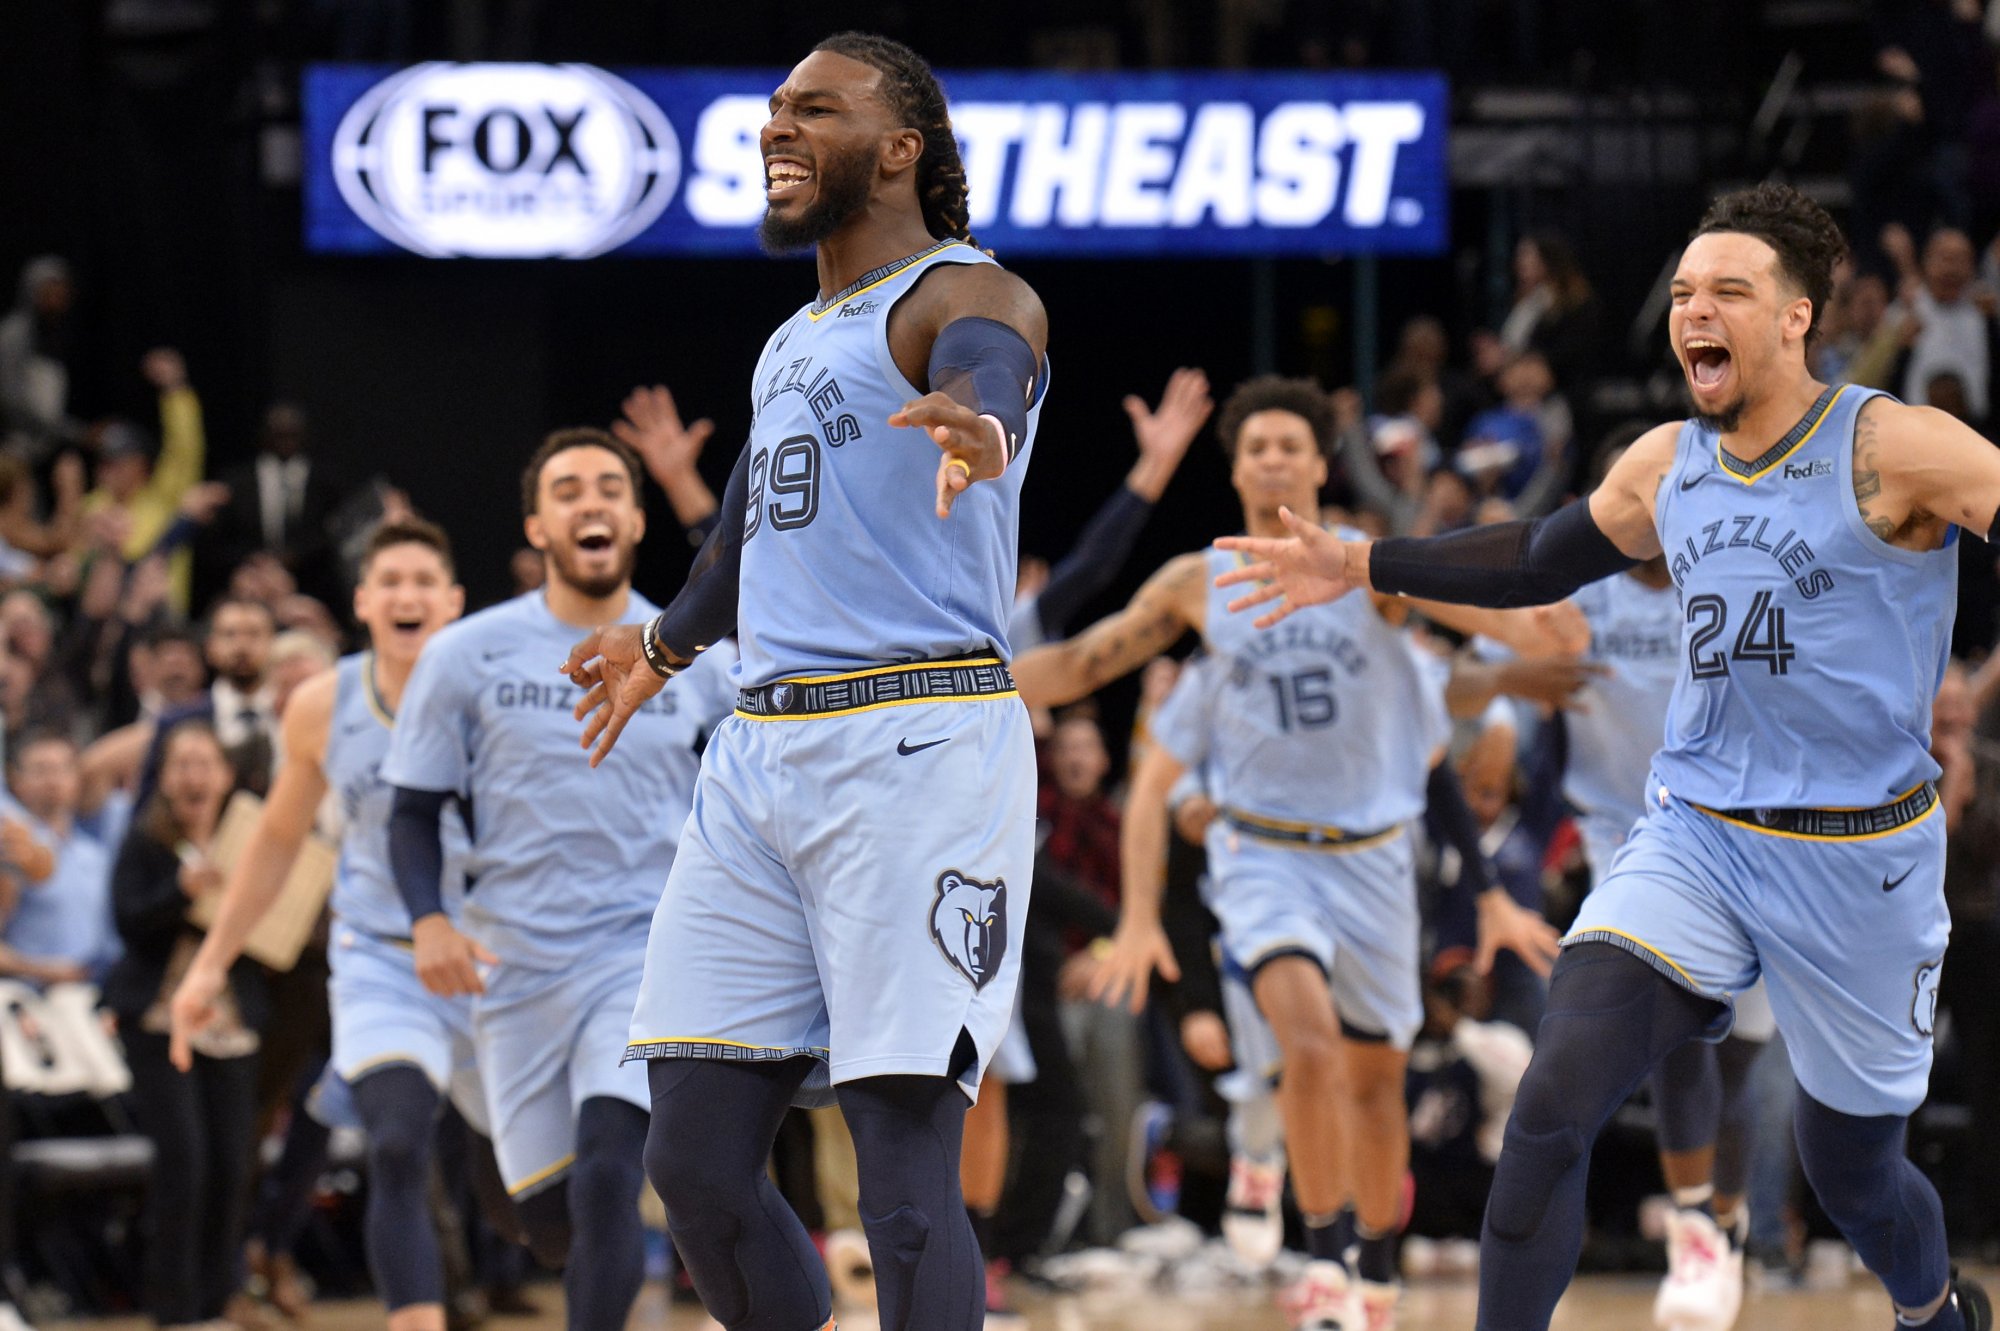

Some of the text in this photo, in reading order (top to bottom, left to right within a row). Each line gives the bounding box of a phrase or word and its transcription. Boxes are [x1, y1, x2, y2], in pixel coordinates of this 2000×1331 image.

[421, 107, 590, 177] FOX
[685, 94, 1426, 228] STHEAST
[837, 301, 879, 318] FedEx
[752, 357, 862, 448] IZZLIES
[742, 433, 821, 546] 99
[1783, 460, 1832, 480] FedEx
[1687, 591, 1796, 681] 24
[496, 681, 678, 716] GRIZES
[1268, 665, 1338, 733] 15
